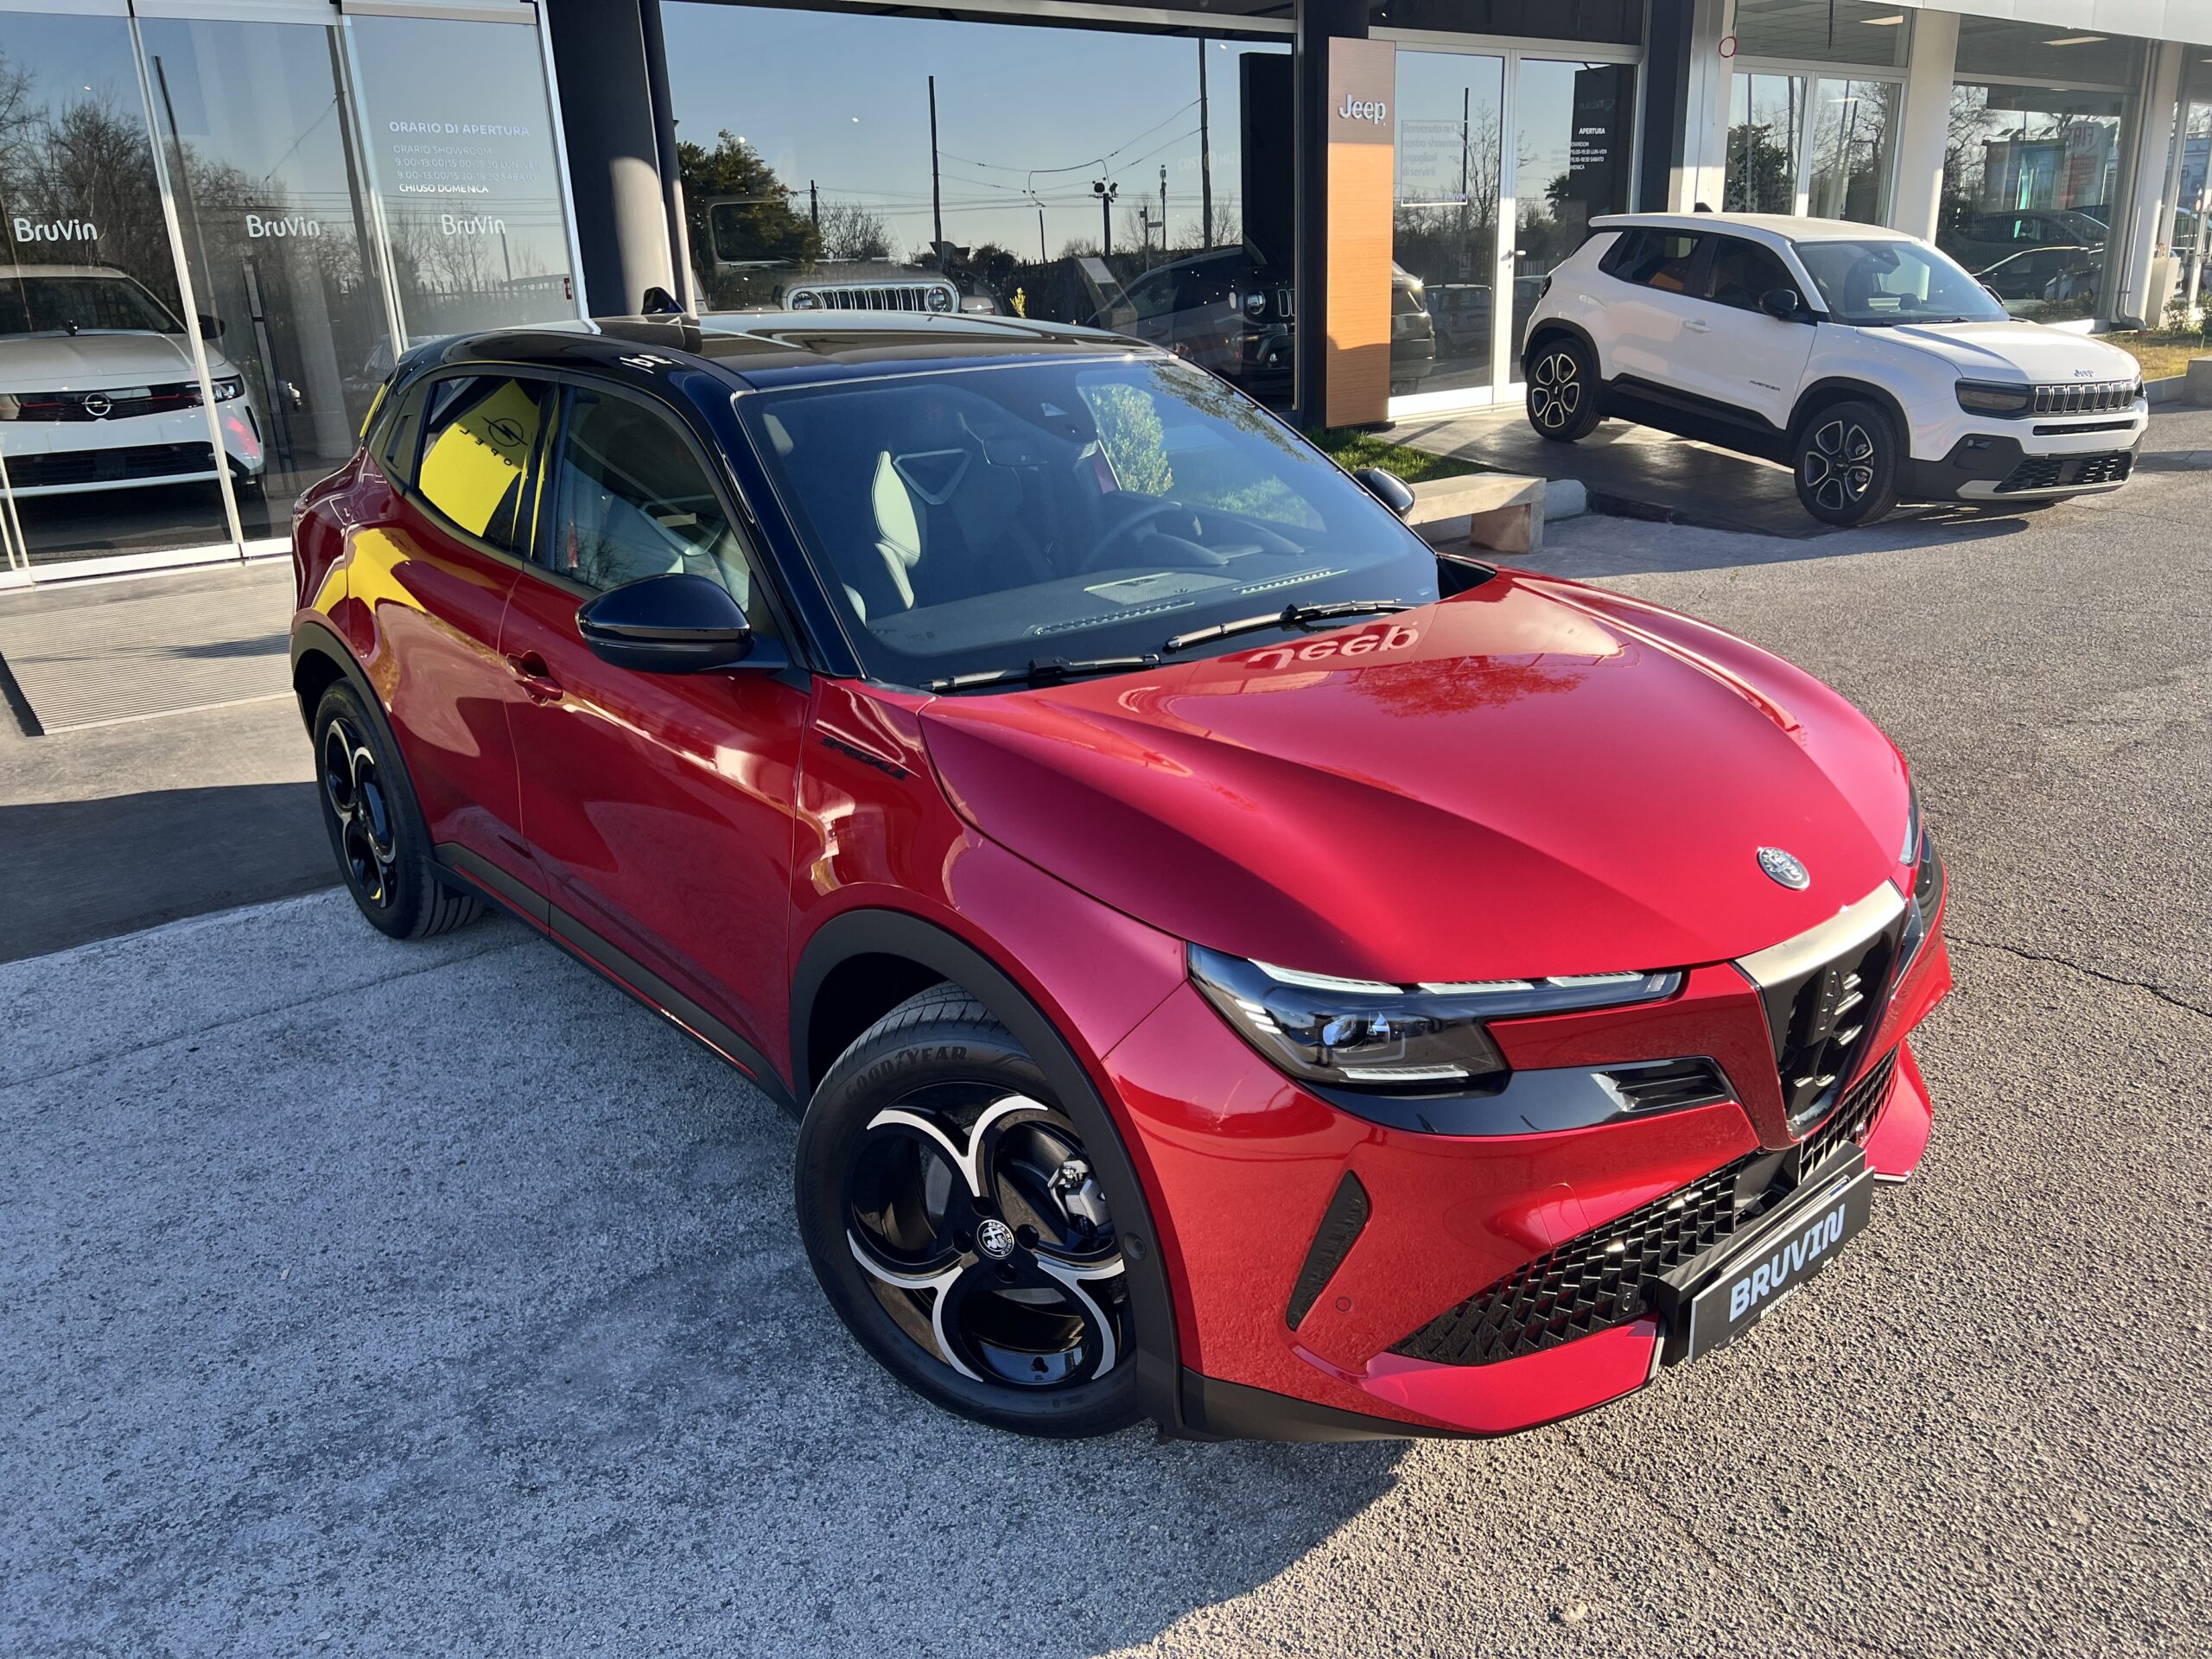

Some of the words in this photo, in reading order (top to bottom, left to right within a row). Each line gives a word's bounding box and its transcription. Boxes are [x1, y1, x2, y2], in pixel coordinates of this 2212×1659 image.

[1338, 94, 1386, 125] Jeep
[389, 121, 441, 134] ORARIO
[445, 123, 459, 134] DI
[462, 124, 530, 137] APERTURA
[393, 145, 430, 154] ORARIO
[432, 145, 492, 156] SHOWROOM
[398, 183, 435, 193] CHIUSO
[437, 184, 489, 194] DOMENICA
[14, 218, 98, 243] BruVin
[246, 215, 321, 238] BruVin
[441, 213, 506, 236] BruVin
[845, 1046, 968, 1100] GOODYEAR
[988, 1222, 1005, 1232] ALFA
[1001, 1233, 1012, 1255] ROMEO
[1729, 1203, 1846, 1323] BRUVIN
